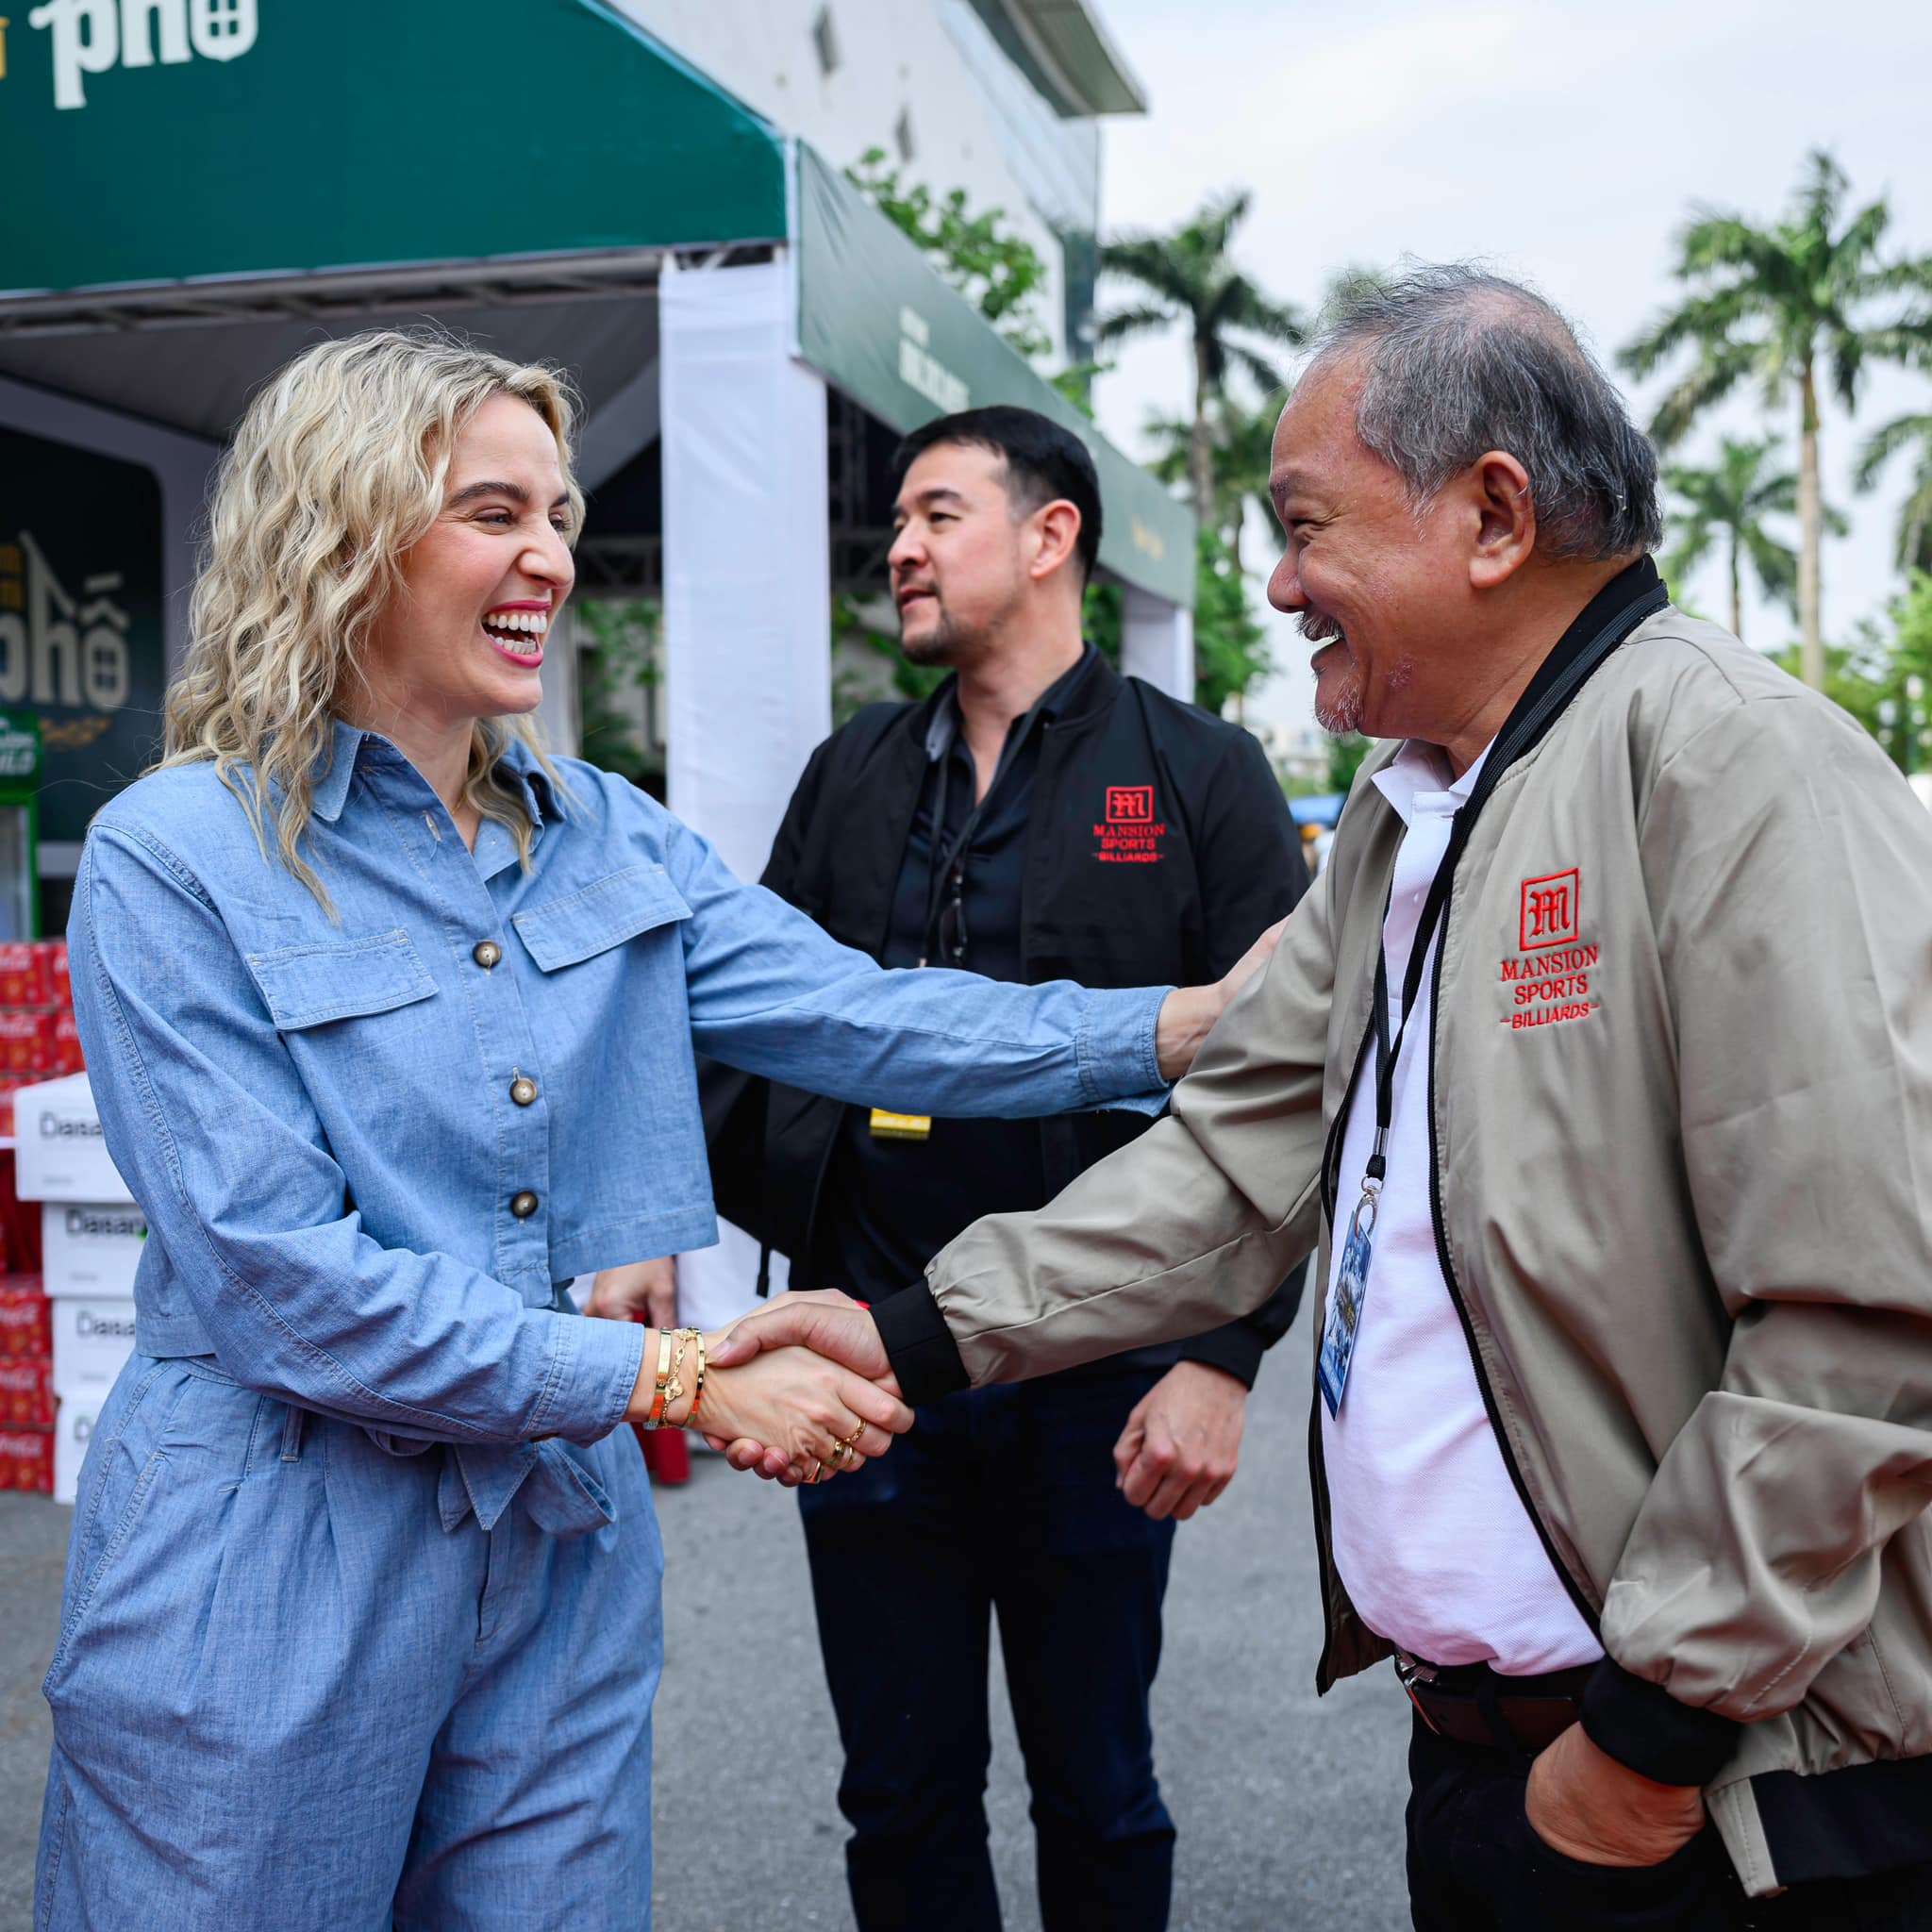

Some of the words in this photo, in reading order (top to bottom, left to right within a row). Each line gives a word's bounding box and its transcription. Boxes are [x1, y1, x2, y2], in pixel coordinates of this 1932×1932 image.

[1093, 824, 1166, 837] MANSION
[1101, 838, 1156, 851] SPORTS
[1500, 944, 1600, 982] MANSION
[1514, 973, 1589, 1005] SPORTS
